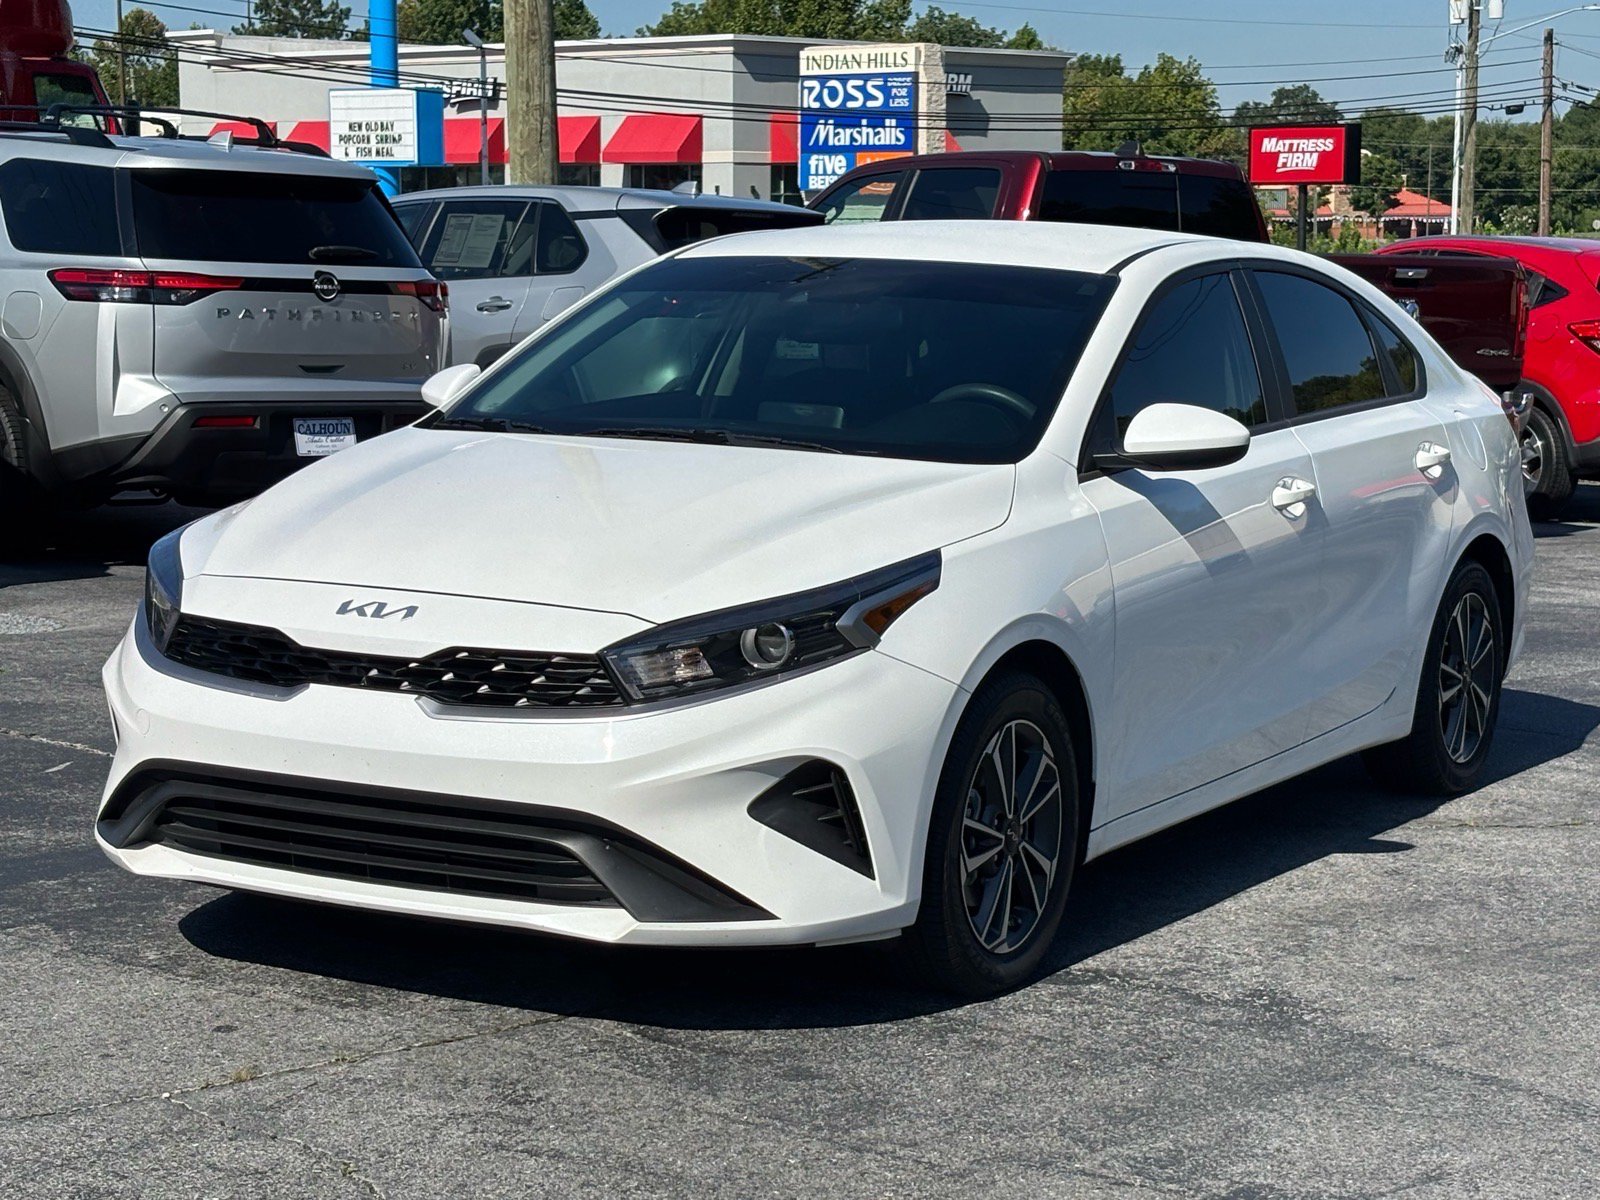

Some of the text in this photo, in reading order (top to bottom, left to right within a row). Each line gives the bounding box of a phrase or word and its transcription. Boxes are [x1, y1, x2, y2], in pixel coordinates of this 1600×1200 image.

[806, 51, 908, 71] INDIAN HILLS
[802, 78, 885, 109] ROSS
[891, 88, 908, 97] FOR
[889, 98, 910, 107] LESS
[348, 122, 363, 133] NEW
[808, 118, 906, 146] Marshalls
[338, 133, 403, 145] POPCORN SHRIMP
[1261, 137, 1334, 153] MATTRESS
[356, 146, 372, 157] FISH
[375, 146, 395, 157] MEAL
[808, 154, 847, 175] five
[1277, 152, 1319, 168] FIRM
[808, 175, 844, 190] BELO
[216, 307, 419, 323] PATHFINDER
[297, 423, 352, 435] CALHOUN
[335, 599, 419, 621] KIA
